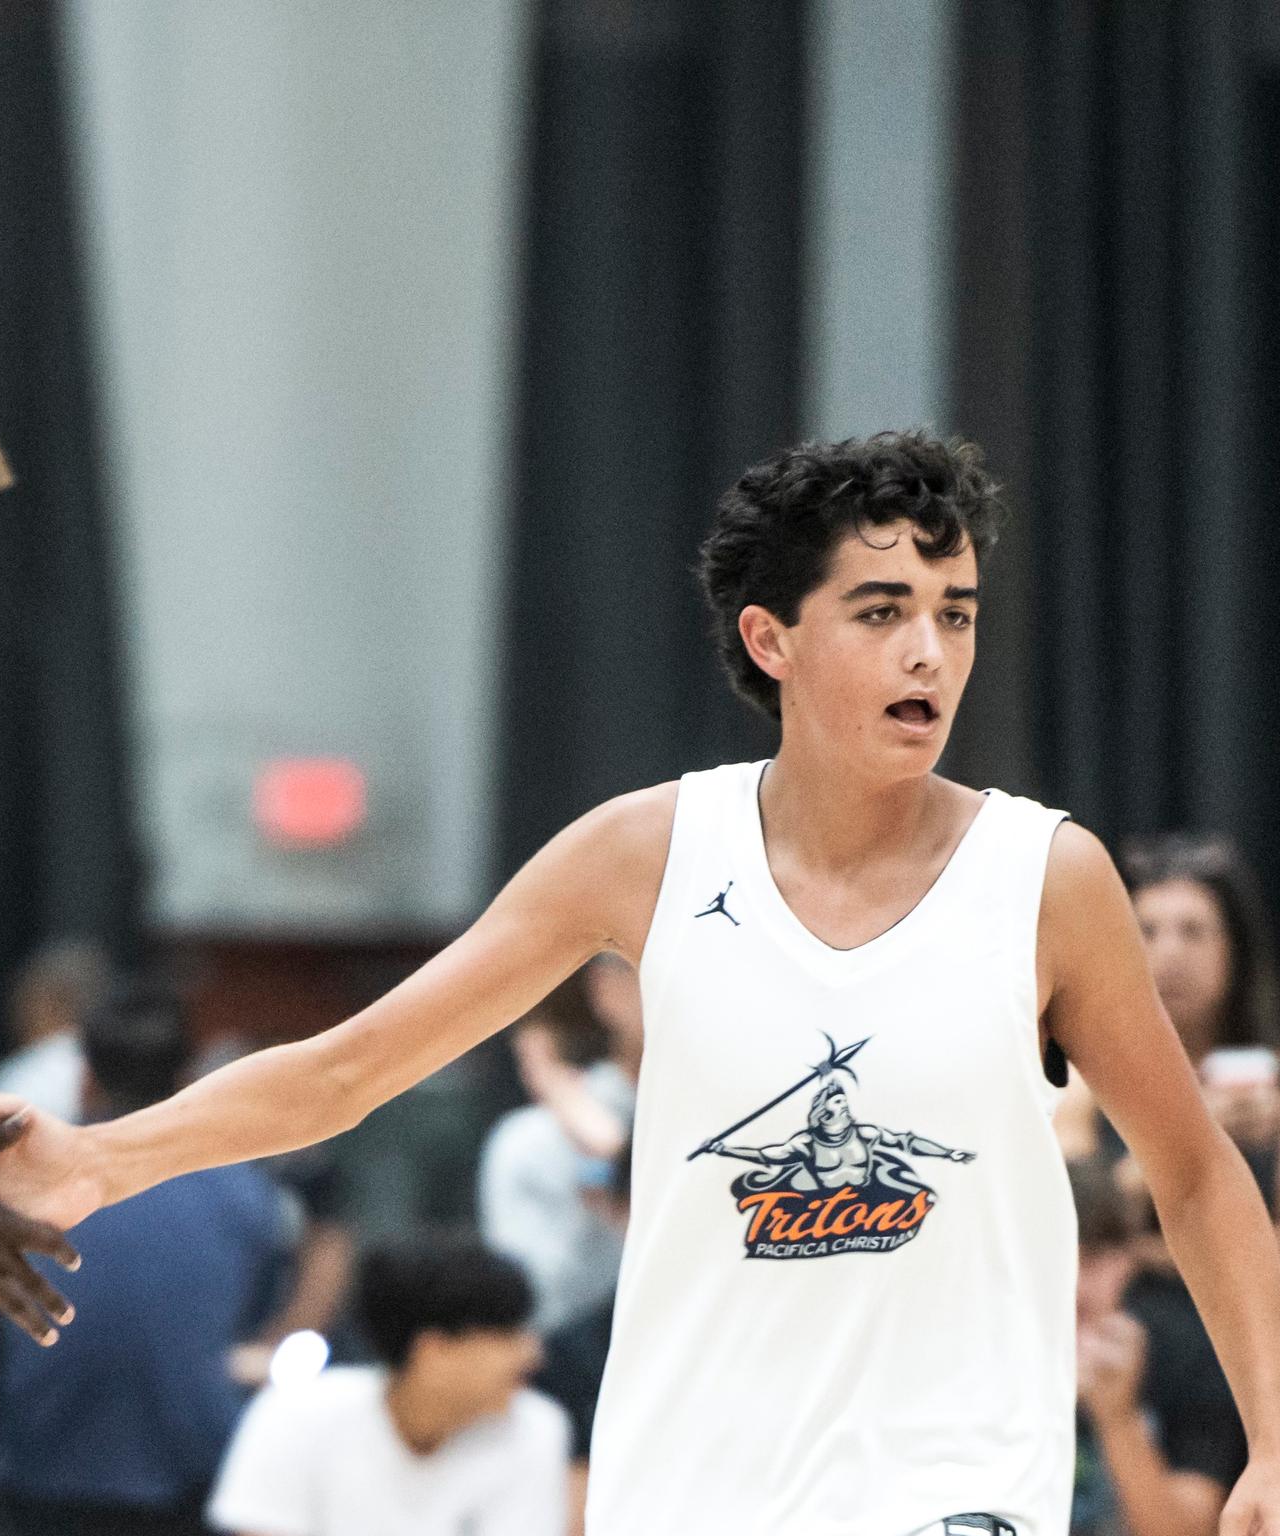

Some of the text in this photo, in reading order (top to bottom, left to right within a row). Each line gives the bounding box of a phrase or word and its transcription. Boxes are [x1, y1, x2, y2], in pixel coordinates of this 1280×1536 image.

[738, 1186, 931, 1243] Tritons
[754, 1228, 916, 1257] PACIFICA CHRISTIAN
